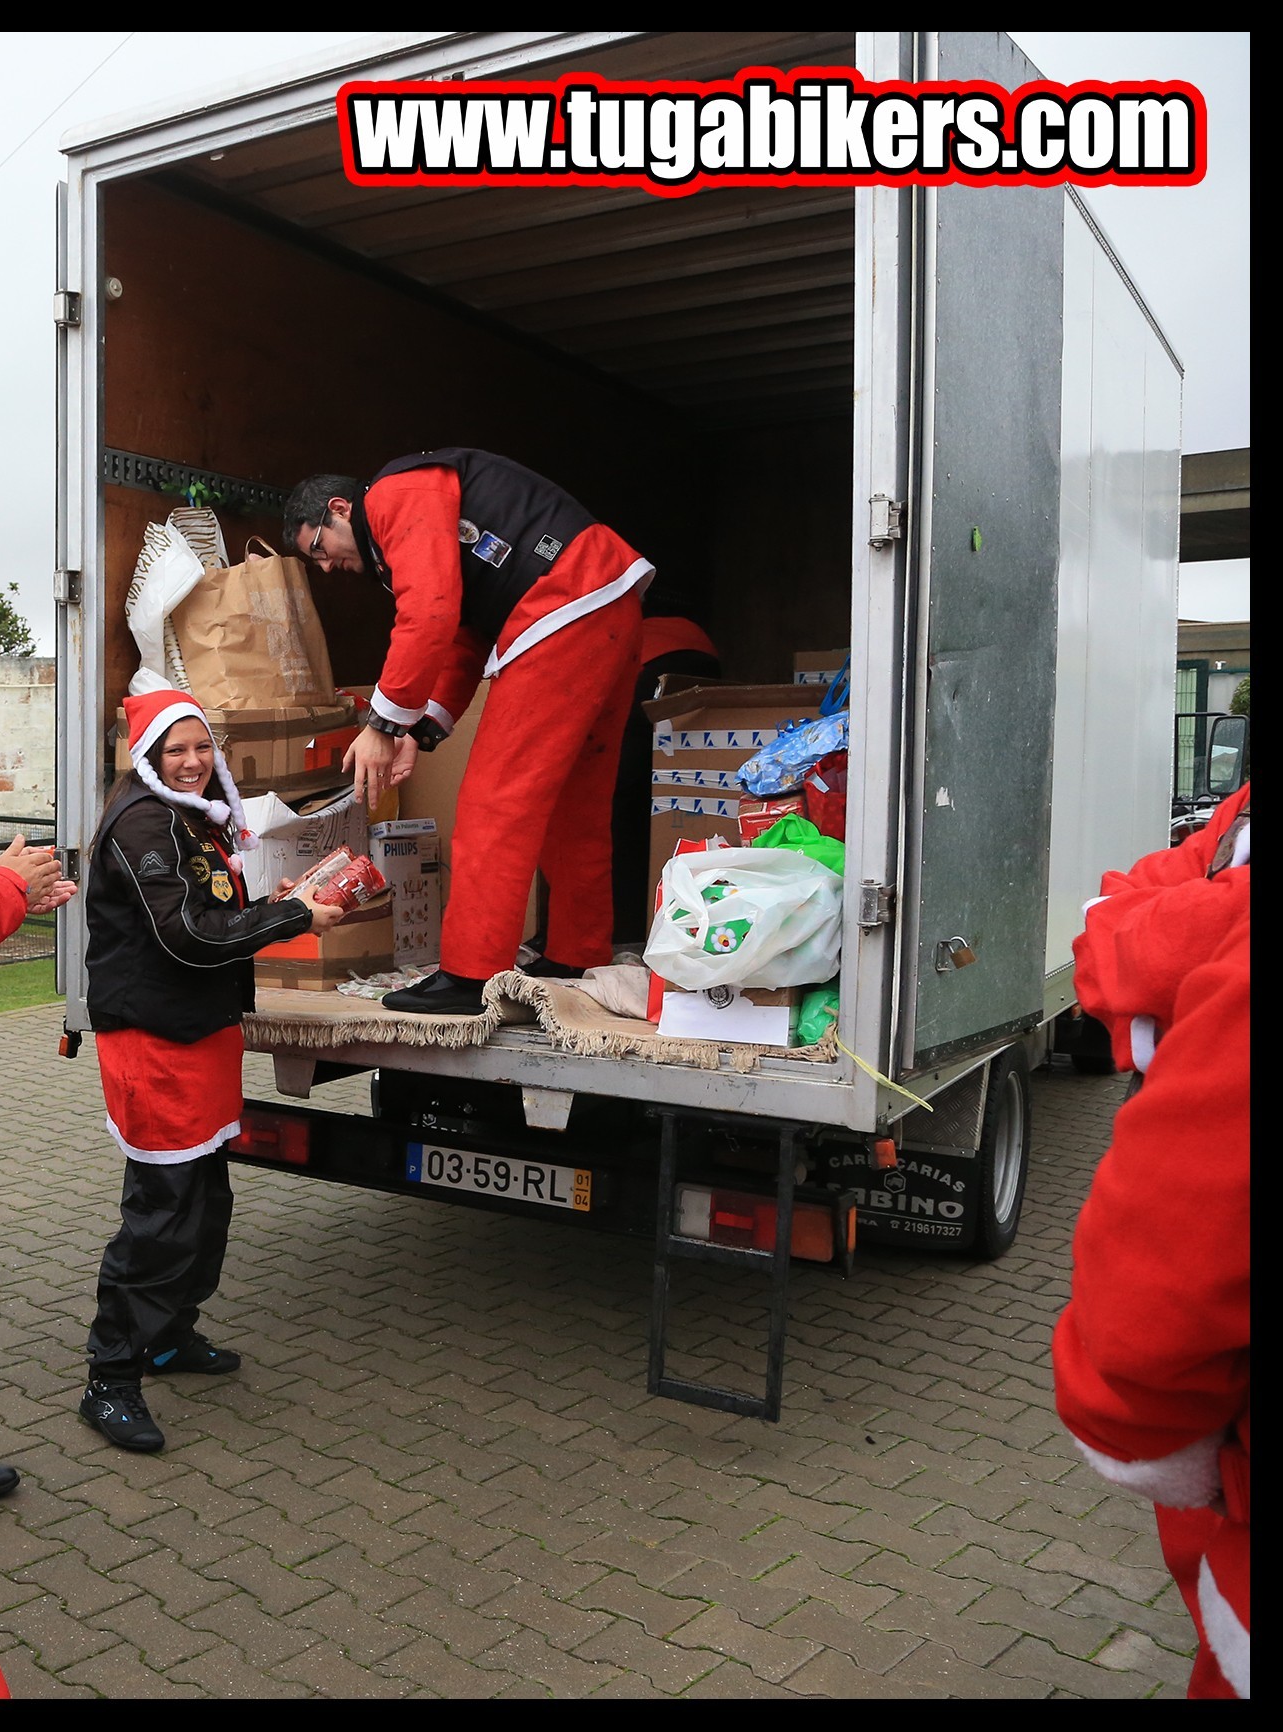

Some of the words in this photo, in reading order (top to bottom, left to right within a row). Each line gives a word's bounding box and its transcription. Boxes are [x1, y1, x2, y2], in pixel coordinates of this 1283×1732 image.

[384, 842, 418, 857] PHILIPS
[409, 1165, 416, 1174] P
[829, 1153, 965, 1193] CARÇARIAS
[576, 1174, 590, 1187] 01
[574, 1194, 589, 1207] 04
[904, 1220, 962, 1237] 219617327
